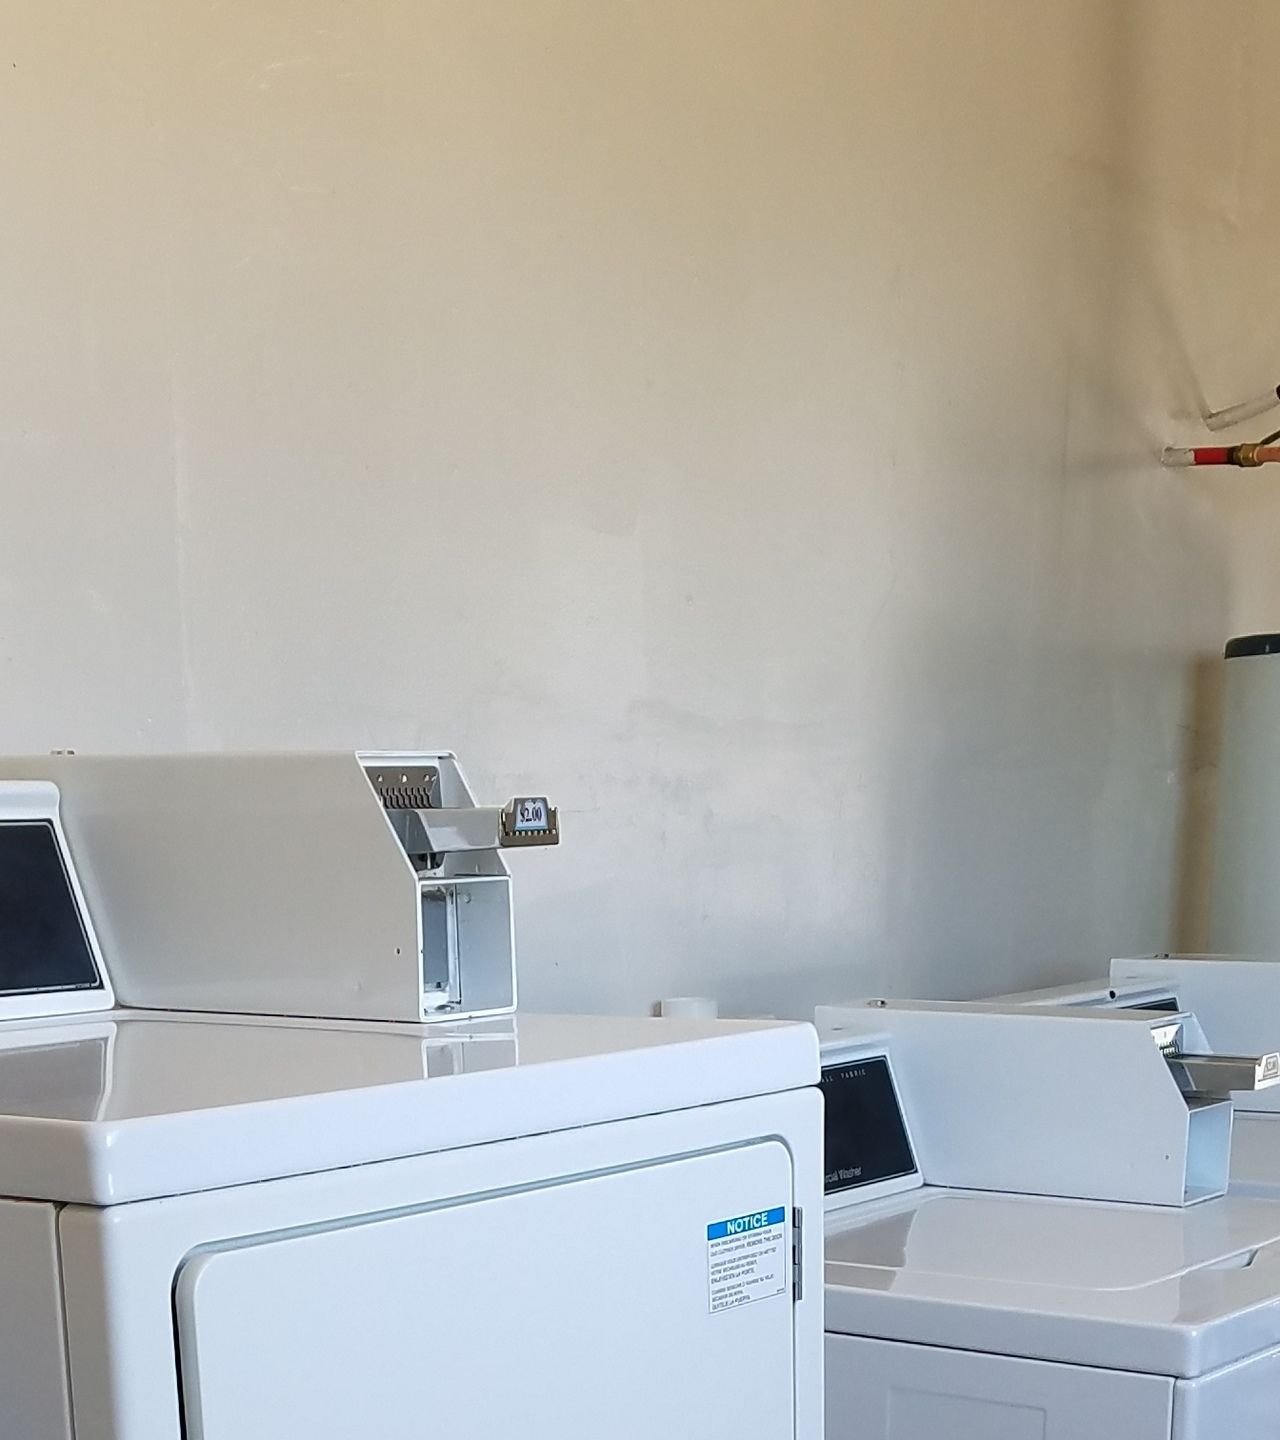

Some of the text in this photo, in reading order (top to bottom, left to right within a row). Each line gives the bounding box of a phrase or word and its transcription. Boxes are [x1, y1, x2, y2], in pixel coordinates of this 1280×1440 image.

[520, 806, 542, 824] $2.00
[840, 1069, 866, 1080] FABRIC
[726, 1211, 769, 1234] NOTICE
